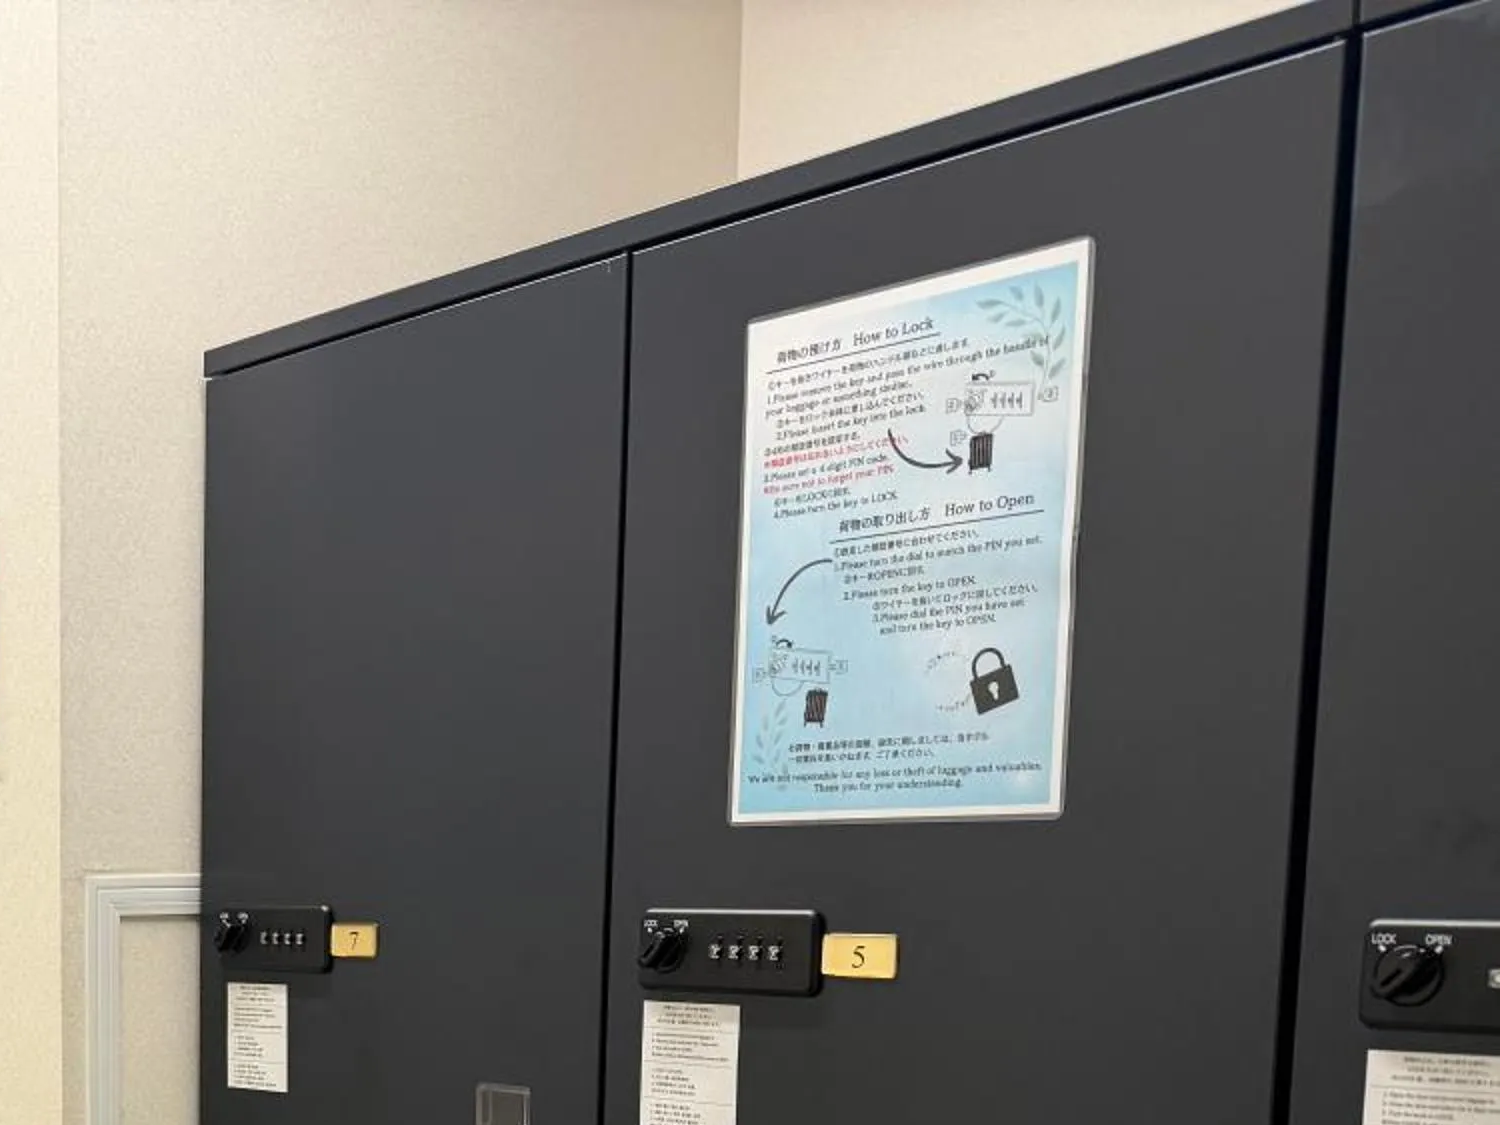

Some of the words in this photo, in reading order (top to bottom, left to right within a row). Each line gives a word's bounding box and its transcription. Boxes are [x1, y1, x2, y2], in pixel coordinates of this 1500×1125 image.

[852, 329, 881, 346] How
[885, 324, 898, 339] to
[902, 316, 933, 335] Lock
[849, 377, 863, 389] key
[945, 352, 982, 368] through
[985, 347, 1000, 358] the
[853, 416, 868, 427] key
[889, 408, 903, 418] the
[839, 507, 929, 533] 荷物の取り出し方
[945, 501, 974, 516] How
[979, 499, 992, 511] to
[996, 494, 1034, 510] Open
[967, 543, 982, 553] the
[984, 540, 1002, 551] PIN
[1004, 539, 1022, 550] you
[917, 582, 932, 593] key
[945, 604, 962, 614] PIN
[919, 621, 933, 630] the
[936, 619, 951, 630] key
[903, 767, 924, 776] theft
[348, 931, 360, 951] 7
[1371, 933, 1396, 945] LOCK
[1425, 933, 1453, 945] OPEN
[850, 945, 865, 969] 5
